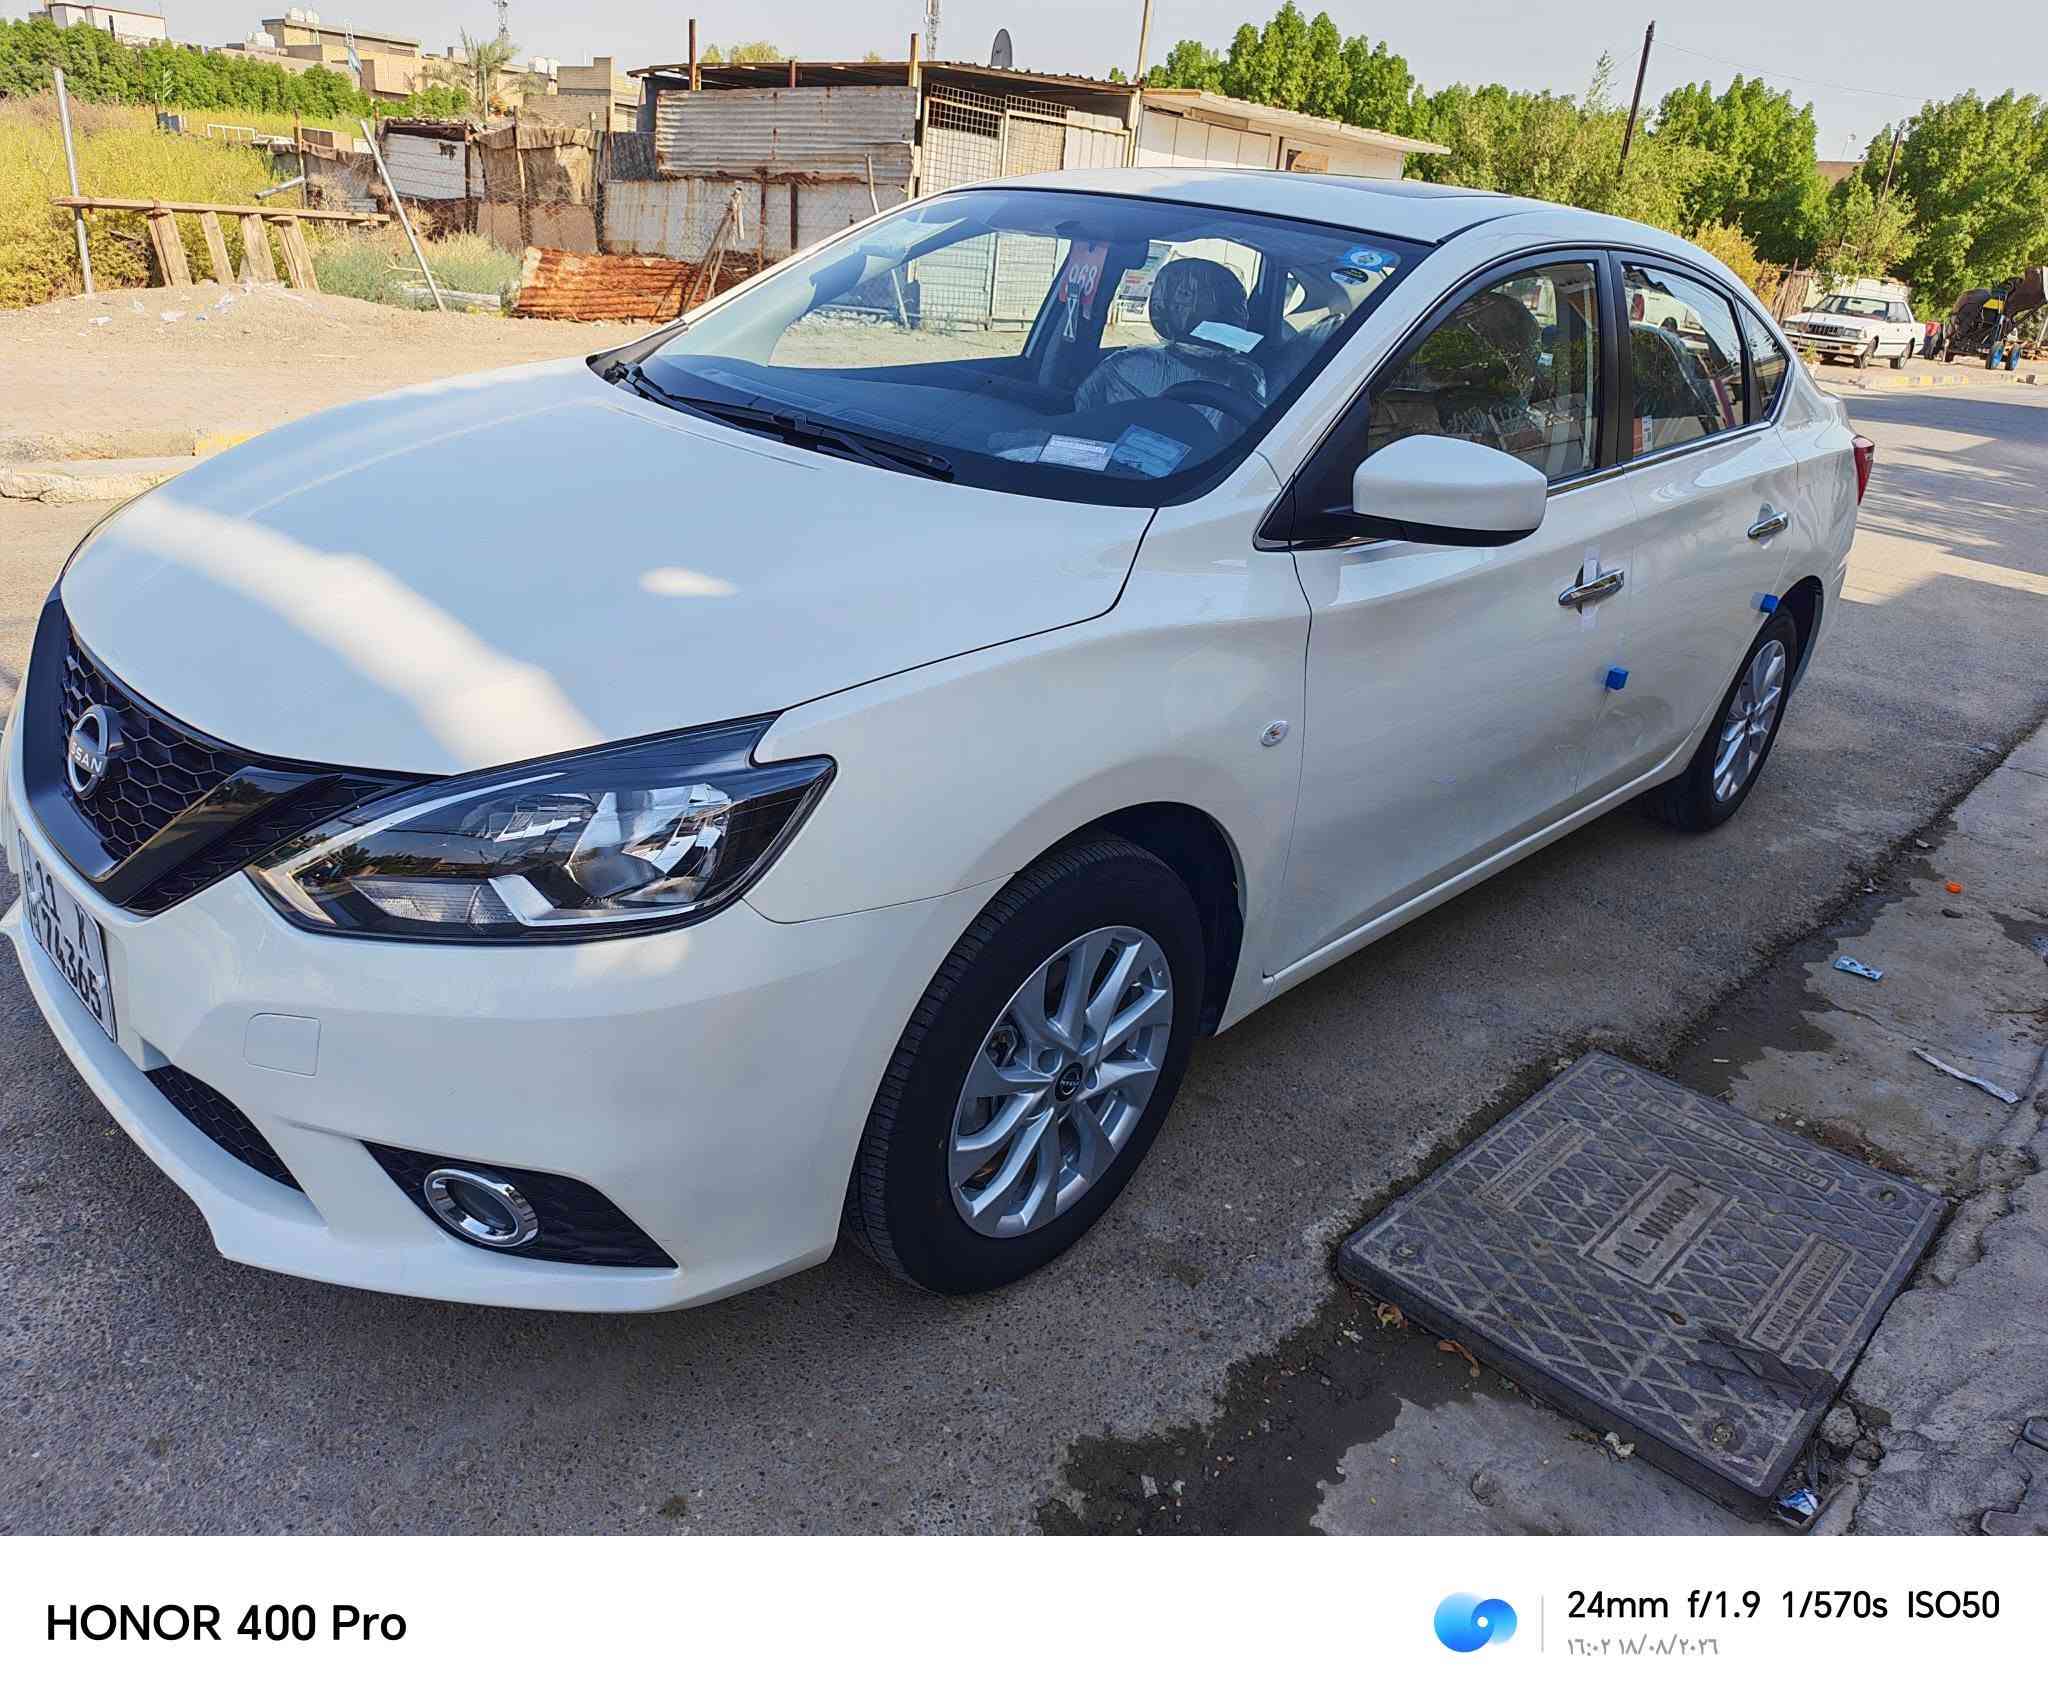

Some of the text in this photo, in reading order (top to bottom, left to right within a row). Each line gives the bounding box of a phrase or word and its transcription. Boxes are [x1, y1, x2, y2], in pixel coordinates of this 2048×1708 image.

[68, 742, 103, 773] SSAN
[35, 860, 61, 923] 11
[73, 901, 90, 960] K
[41, 906, 103, 1020] 74365
